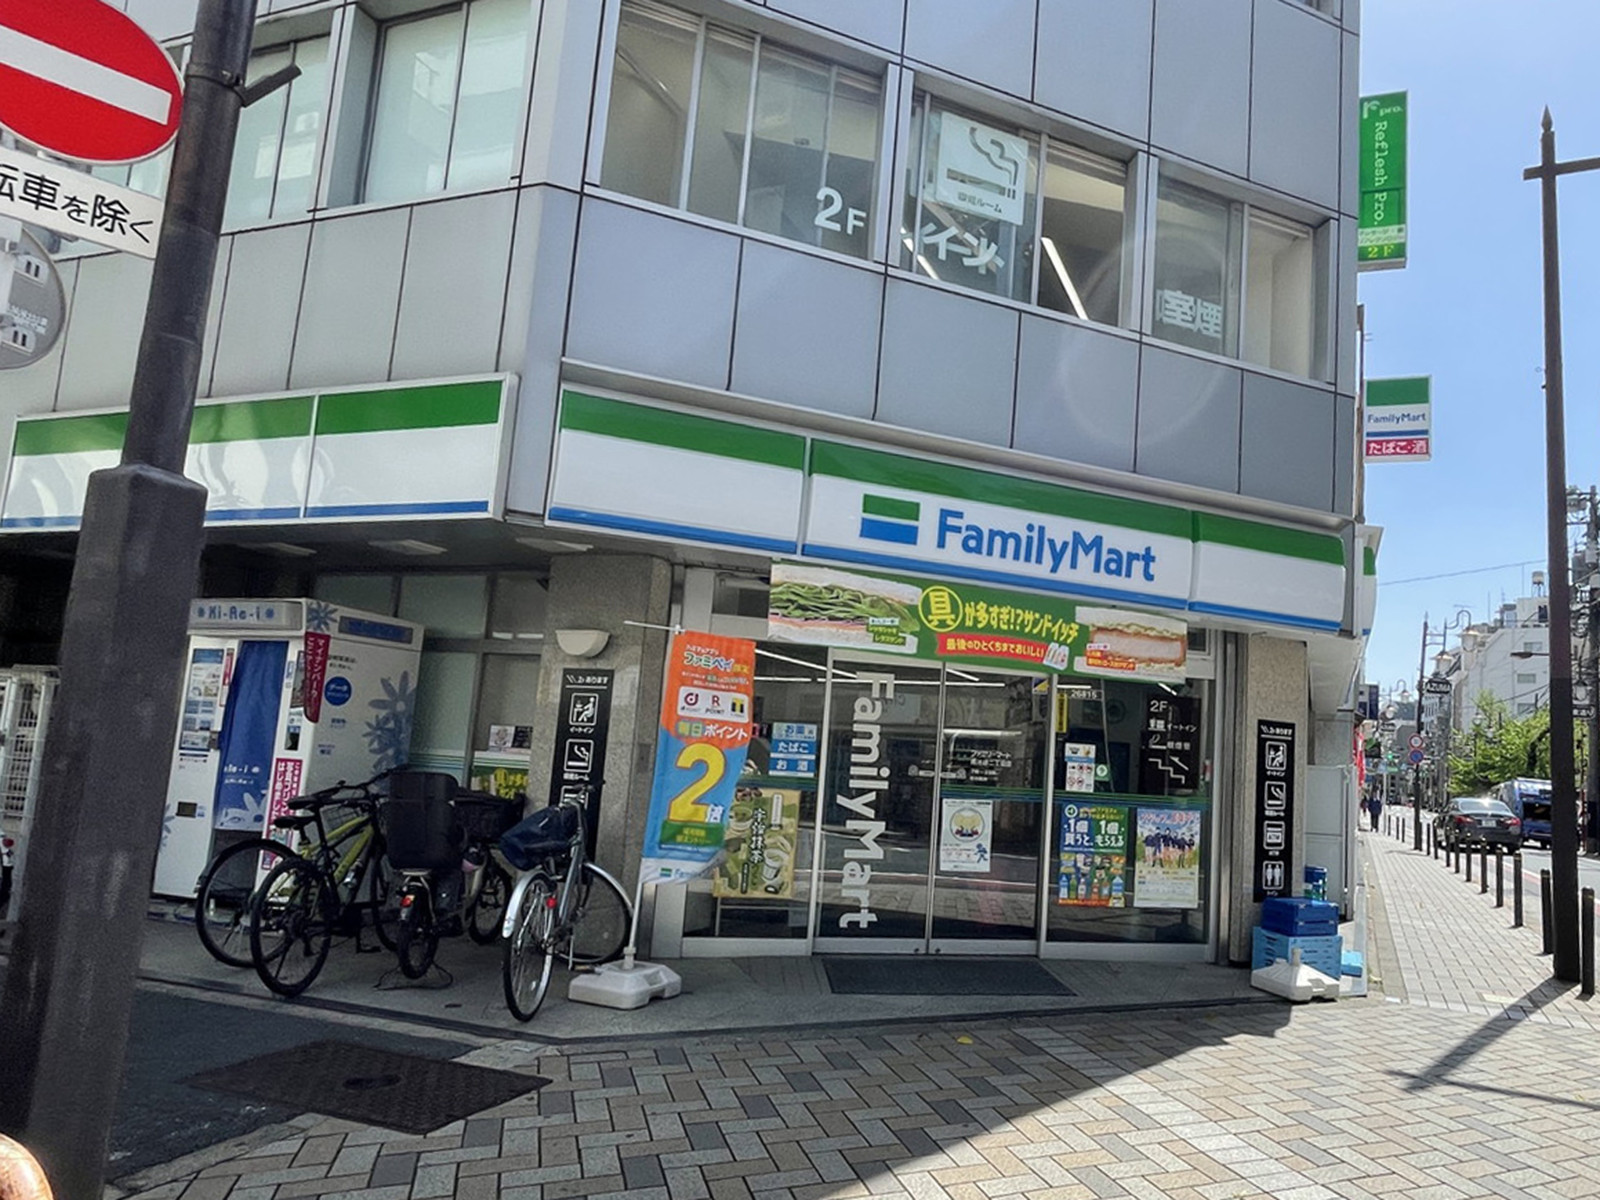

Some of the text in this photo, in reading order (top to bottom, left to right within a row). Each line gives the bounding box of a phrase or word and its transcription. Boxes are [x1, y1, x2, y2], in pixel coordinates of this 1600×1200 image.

[1374, 121, 1388, 187] Reflesh
[814, 186, 867, 235] 2F
[1367, 413, 1426, 424] FamilyMart
[937, 508, 1156, 582] FamilyMart
[684, 651, 734, 672] ファミペイ
[1150, 699, 1168, 712] 2F
[778, 741, 809, 753] たばこ
[836, 672, 895, 929] FamilyMart
